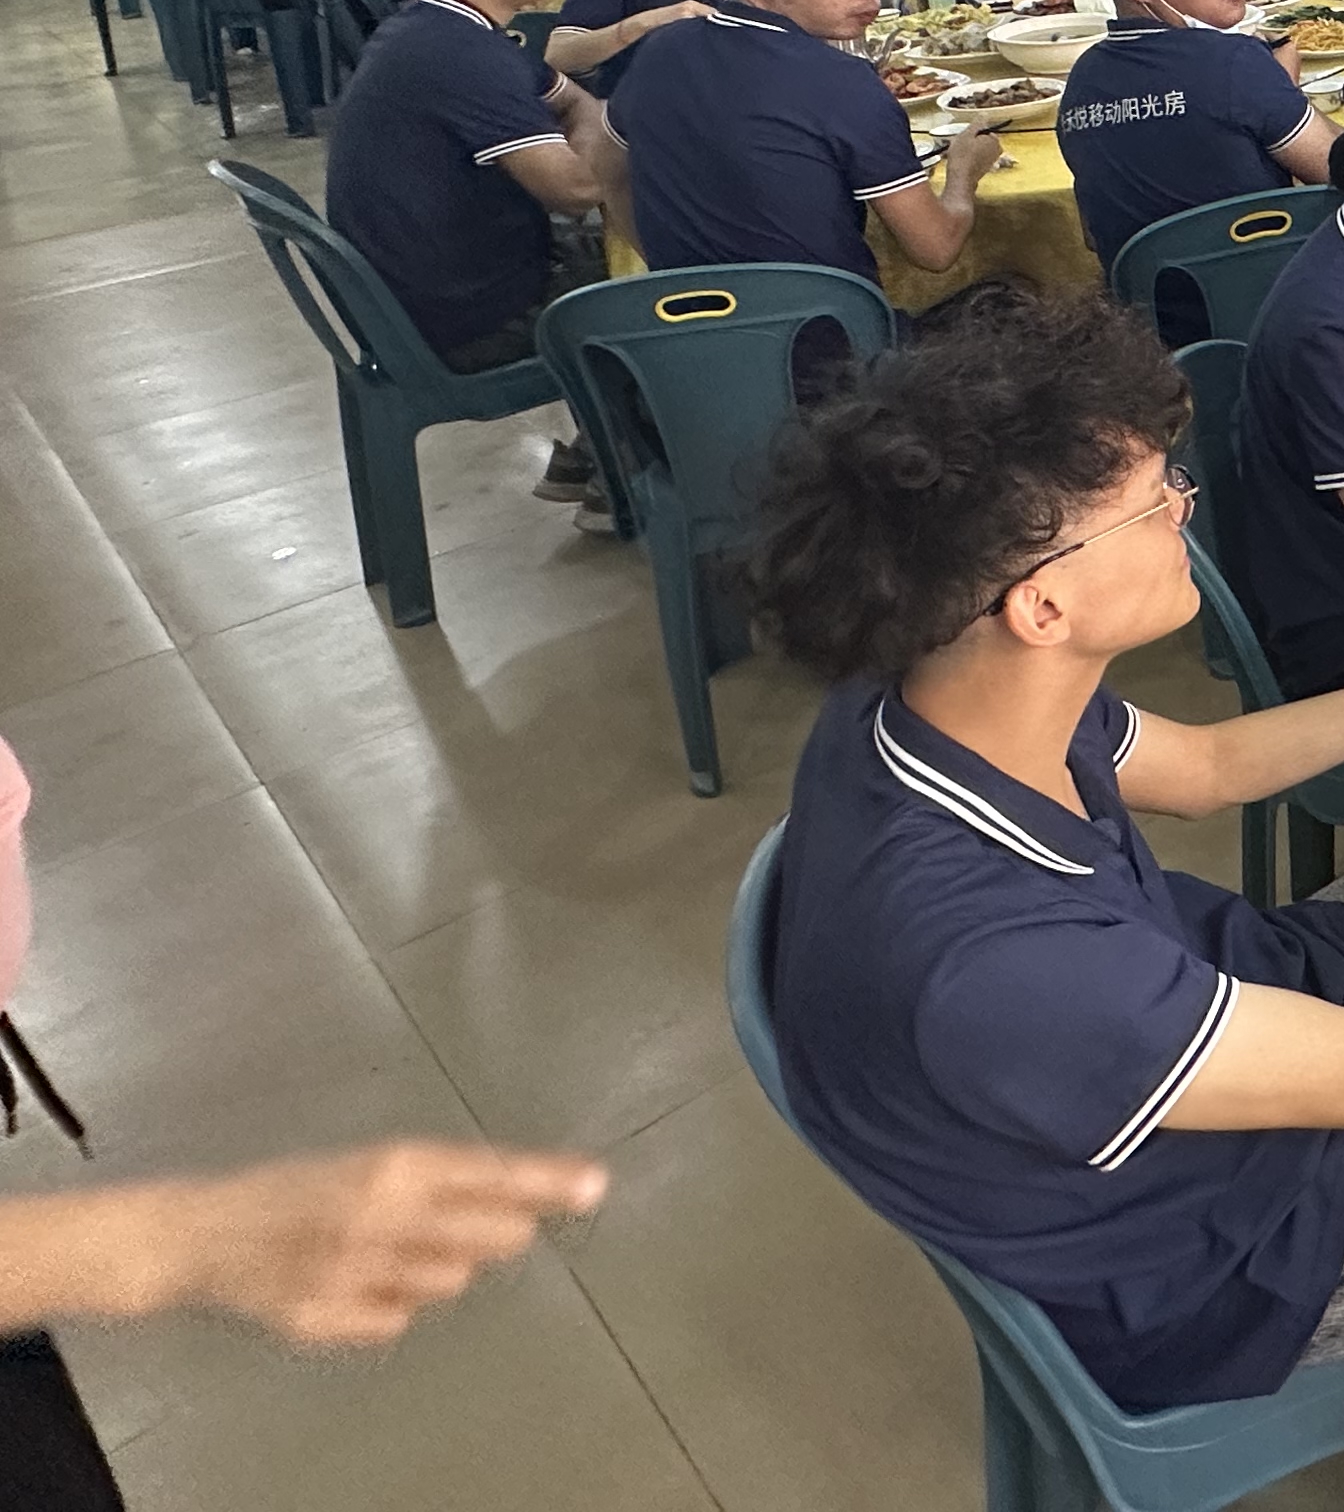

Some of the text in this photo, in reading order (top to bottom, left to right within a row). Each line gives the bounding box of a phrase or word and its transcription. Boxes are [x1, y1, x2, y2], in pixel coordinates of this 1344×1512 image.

[1061, 90, 1187, 133] 禾悦移动阳光房
